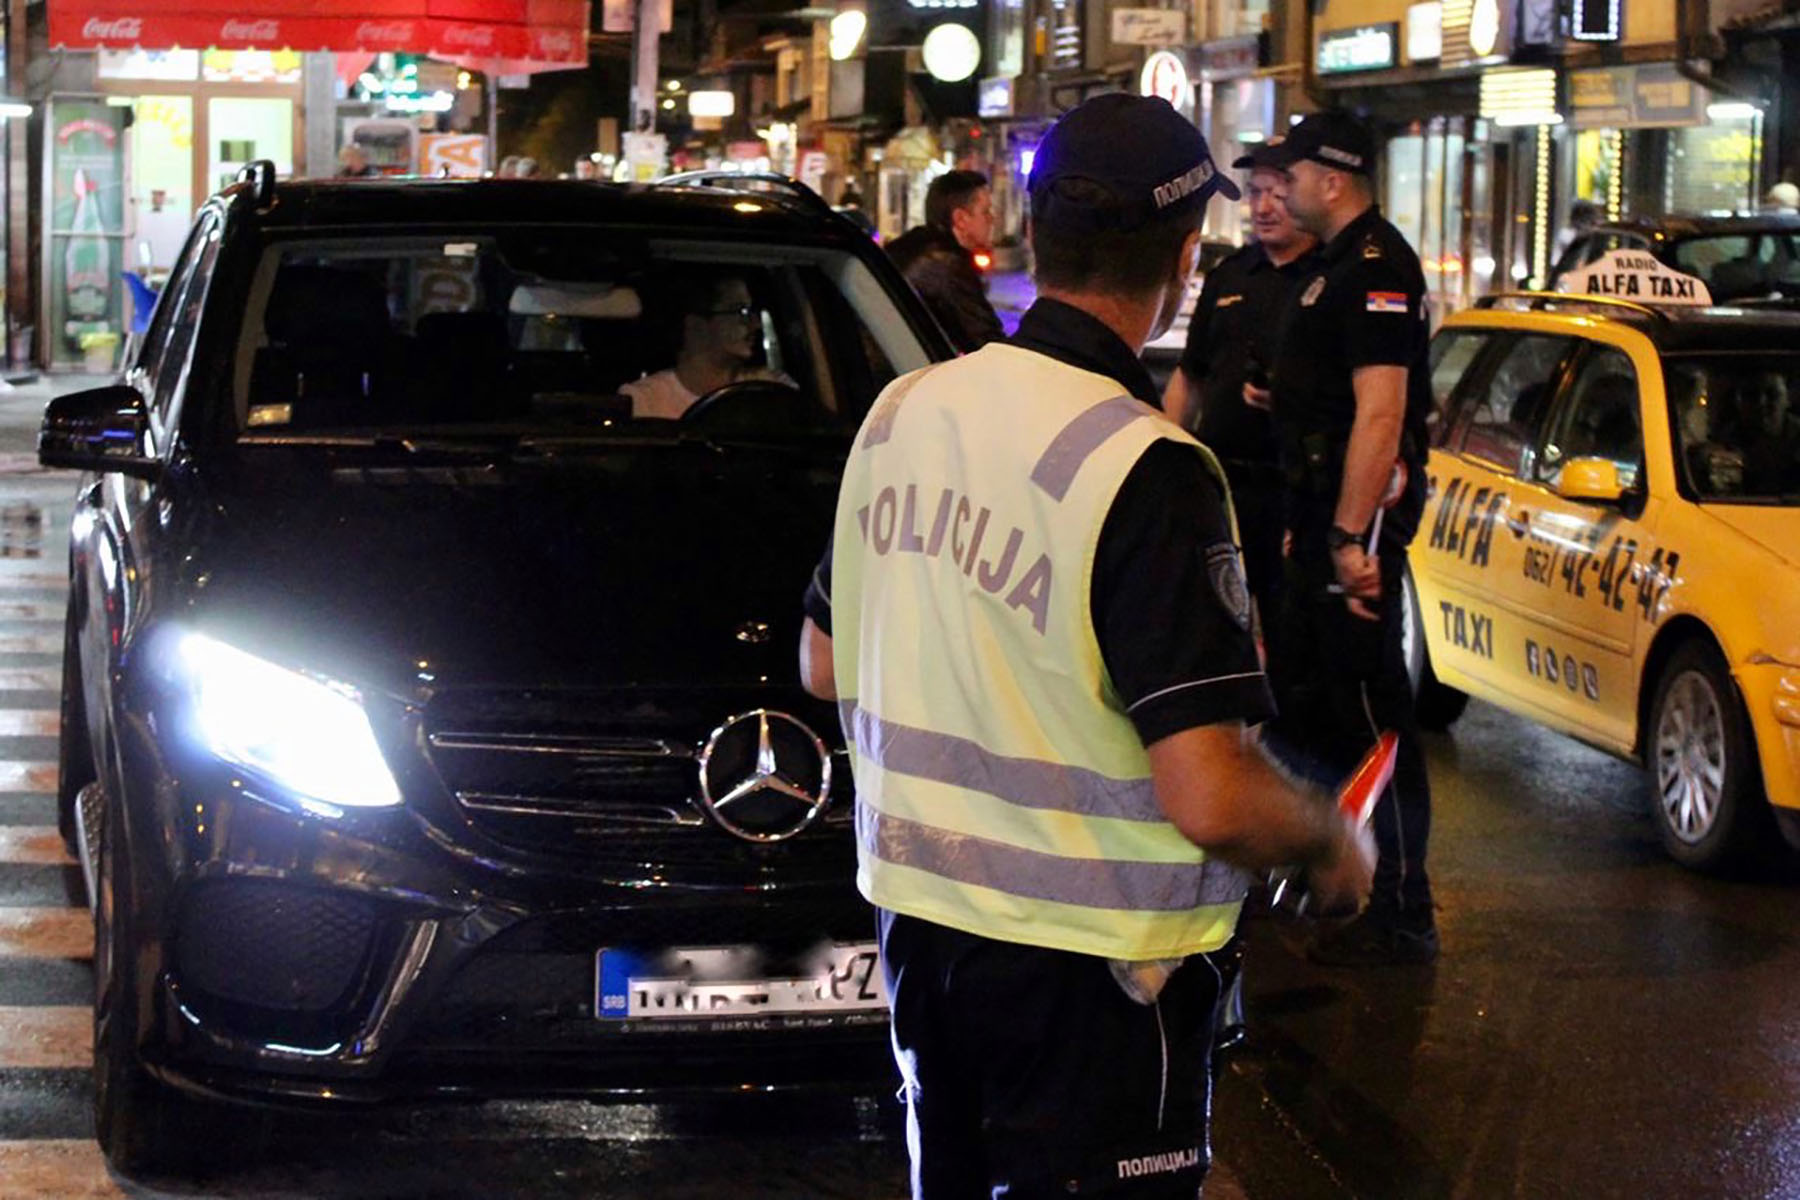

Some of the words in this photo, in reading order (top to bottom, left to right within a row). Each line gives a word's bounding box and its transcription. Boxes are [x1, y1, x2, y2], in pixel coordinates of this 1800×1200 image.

[1615, 257, 1657, 271] RADIO
[1587, 274, 1639, 296] ALFA
[1649, 275, 1695, 298] TAXI
[1430, 477, 1506, 567] ALFA
[1440, 600, 1493, 660] TAXI
[603, 994, 626, 1010] SRB
